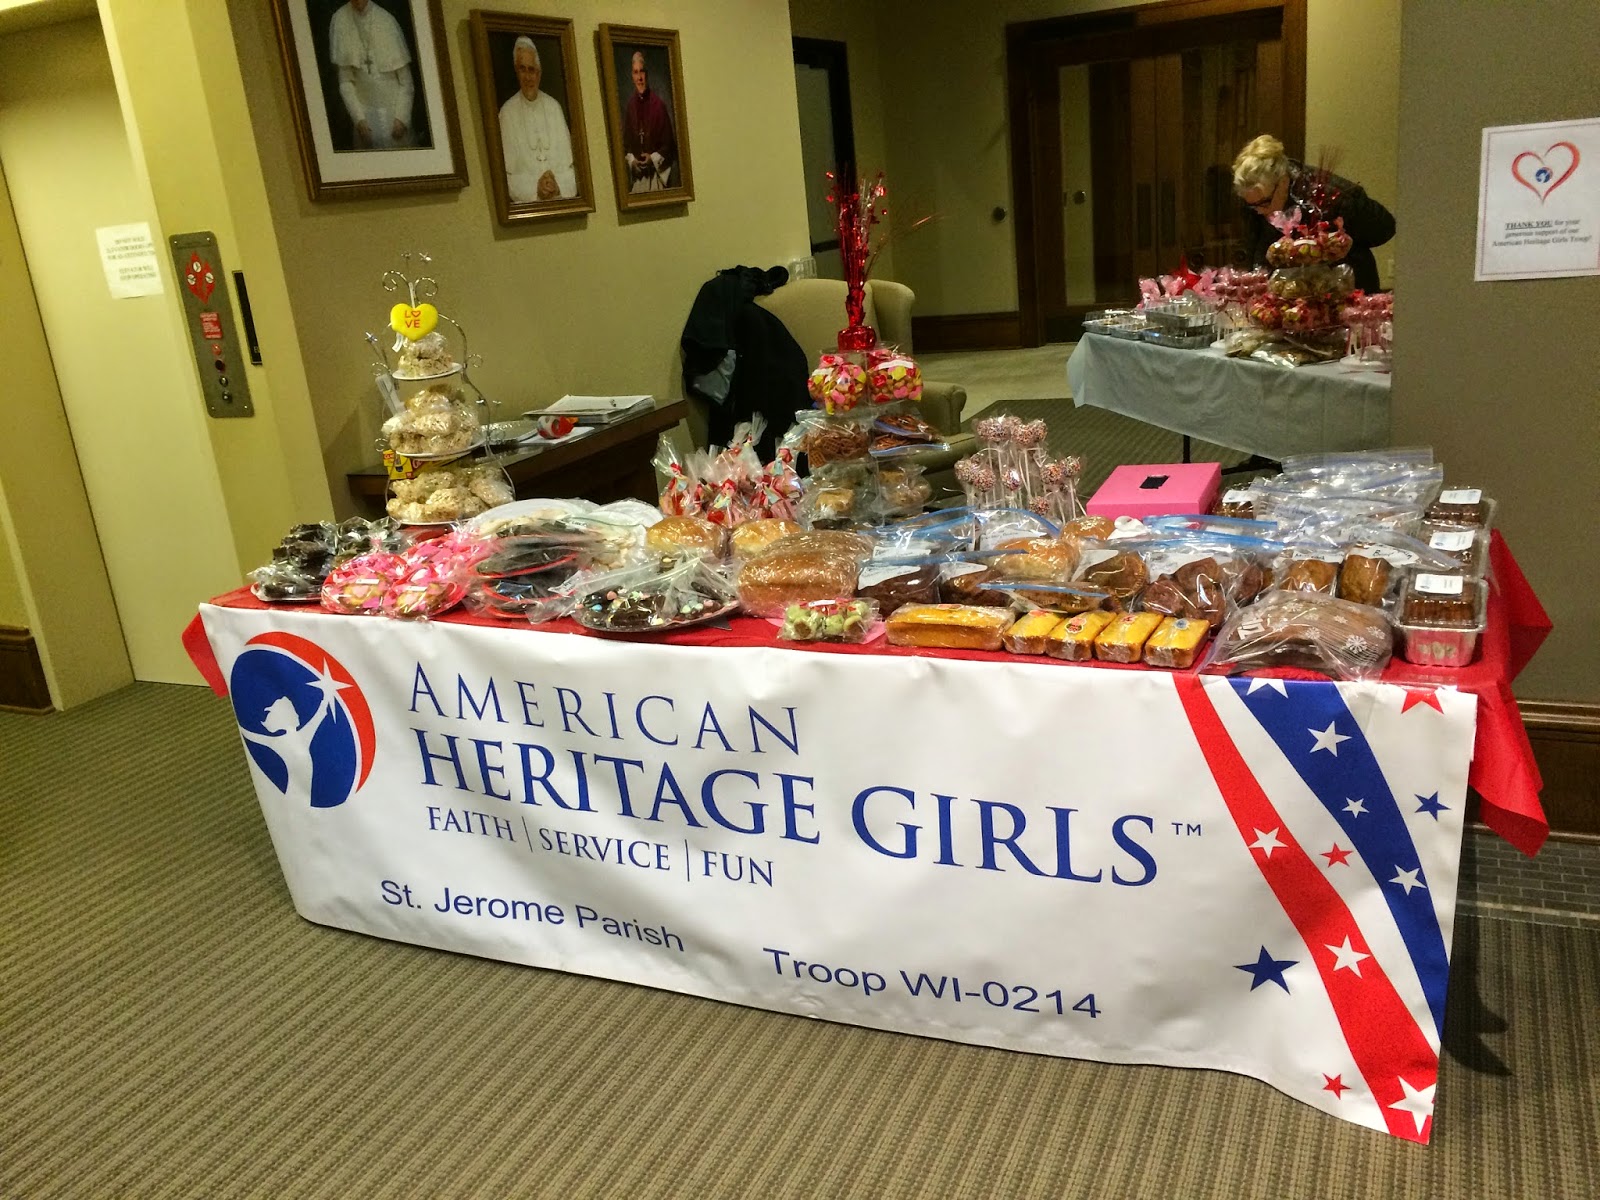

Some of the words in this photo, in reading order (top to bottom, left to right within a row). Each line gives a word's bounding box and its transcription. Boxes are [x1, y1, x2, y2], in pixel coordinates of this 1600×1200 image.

[1505, 221, 1534, 230] THANK
[1536, 220, 1553, 229] YOU
[1523, 238, 1551, 246] Heritage
[408, 661, 799, 755] AMERICAN
[410, 728, 820, 845] HERITAGE
[851, 785, 1158, 886] GIRLS
[426, 806, 516, 842] FAITH
[538, 827, 672, 871] SERVICE
[703, 850, 774, 887] FUN
[381, 879, 423, 909] St.
[434, 887, 565, 925] Jerome
[575, 904, 685, 952] Parish
[763, 947, 887, 996] Troop
[900, 970, 1102, 1018] WI-0214
